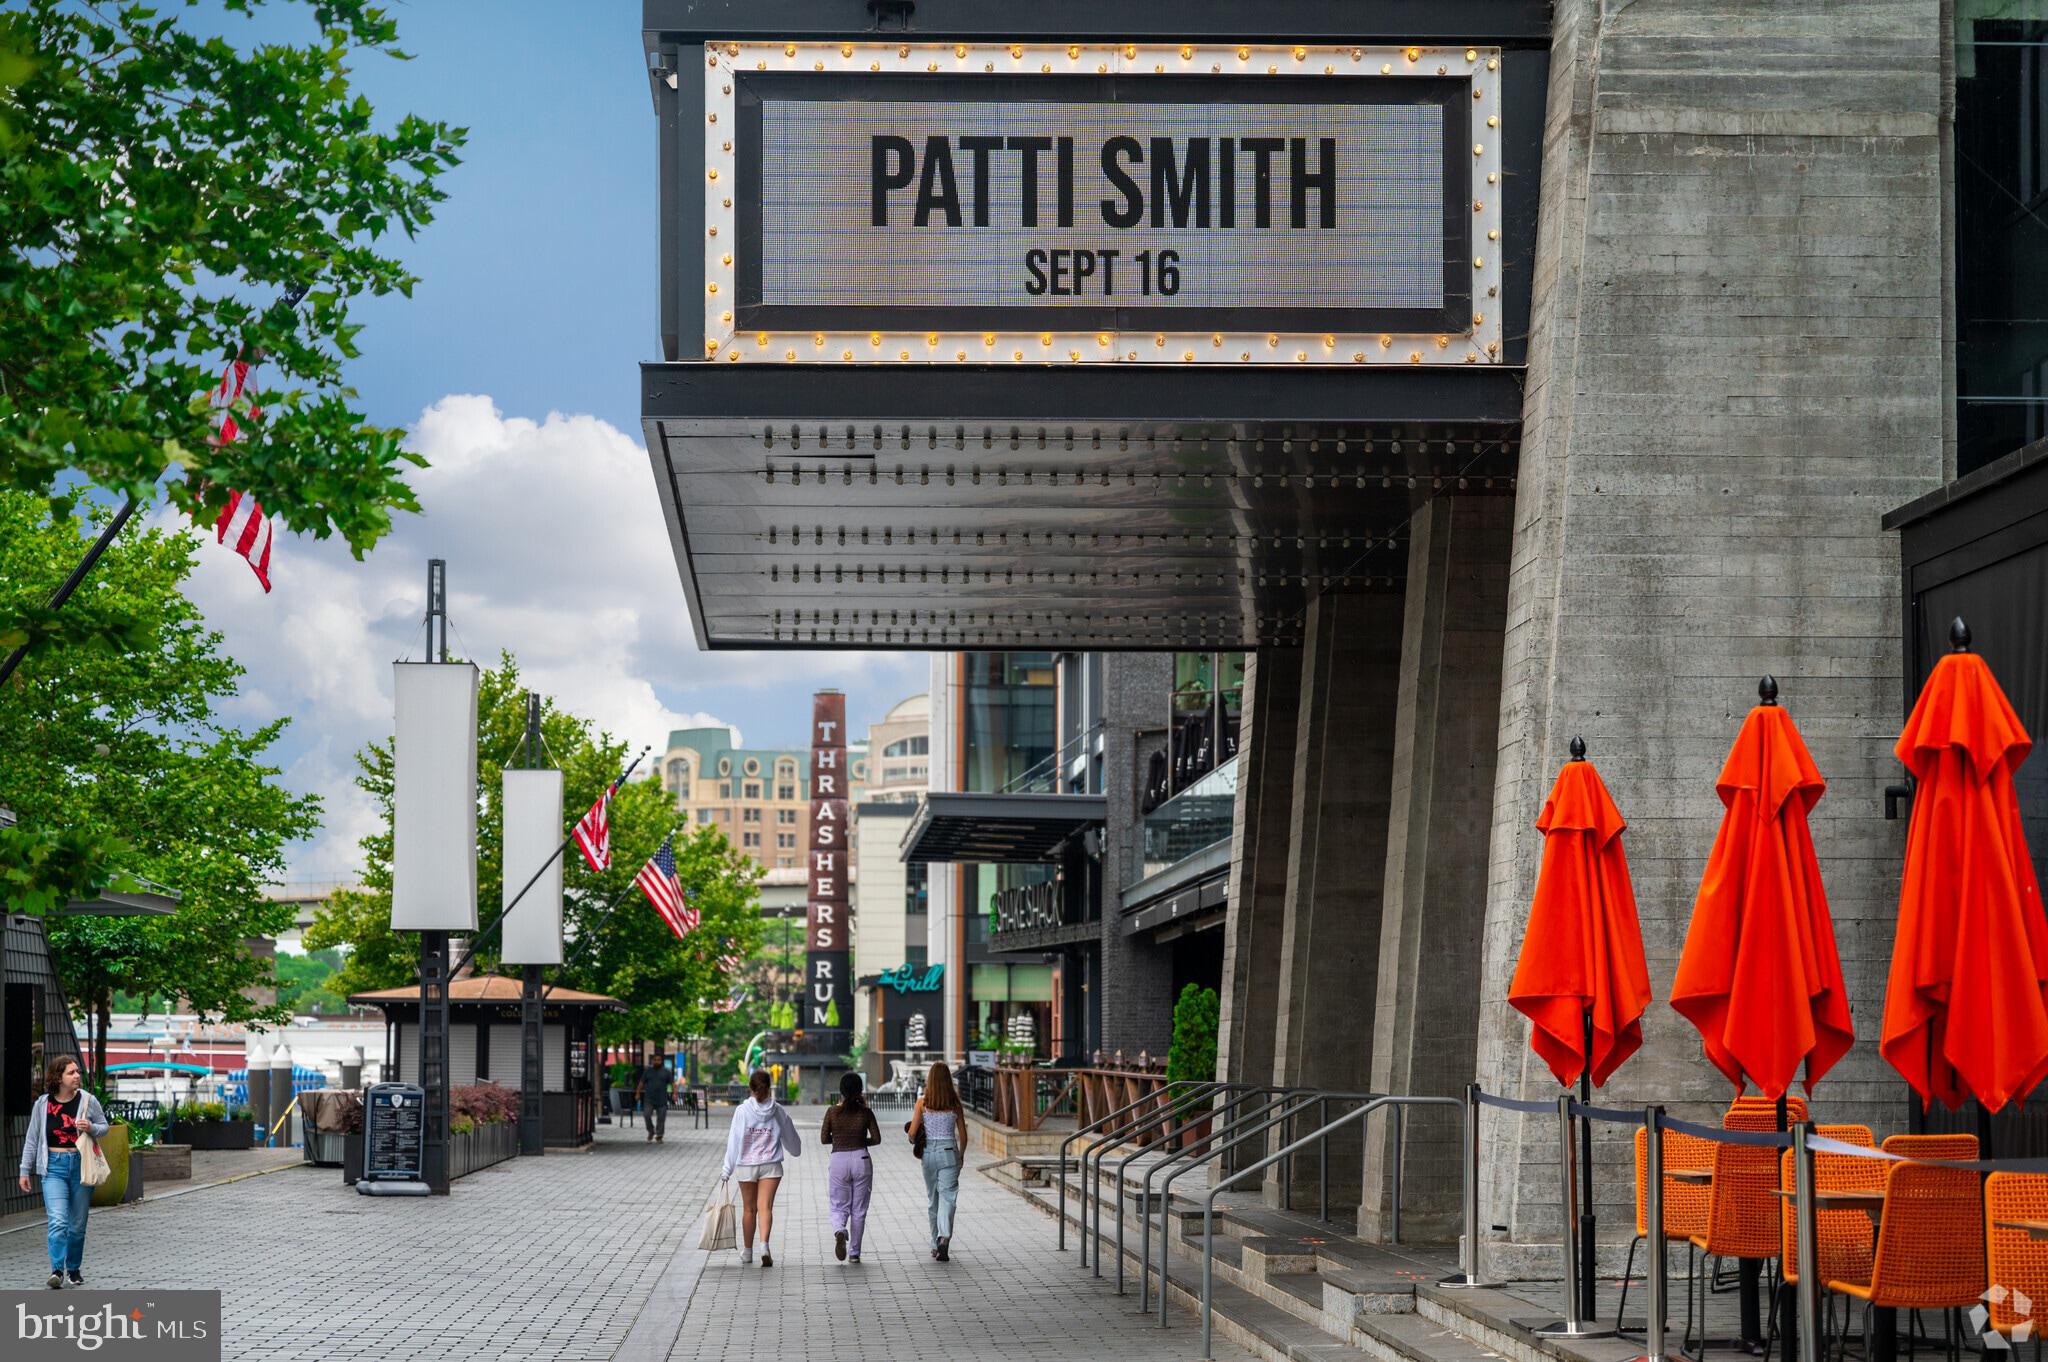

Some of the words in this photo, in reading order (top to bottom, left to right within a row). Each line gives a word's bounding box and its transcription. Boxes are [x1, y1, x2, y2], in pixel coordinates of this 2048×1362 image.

[872, 136, 1074, 228] PATTI
[1101, 136, 1336, 229] SMITH
[1025, 248, 1120, 296] SEPT
[1135, 249, 1180, 296] 16
[816, 721, 836, 947] THRASHERS
[814, 960, 834, 1024] RUM
[893, 962, 945, 994] Grill
